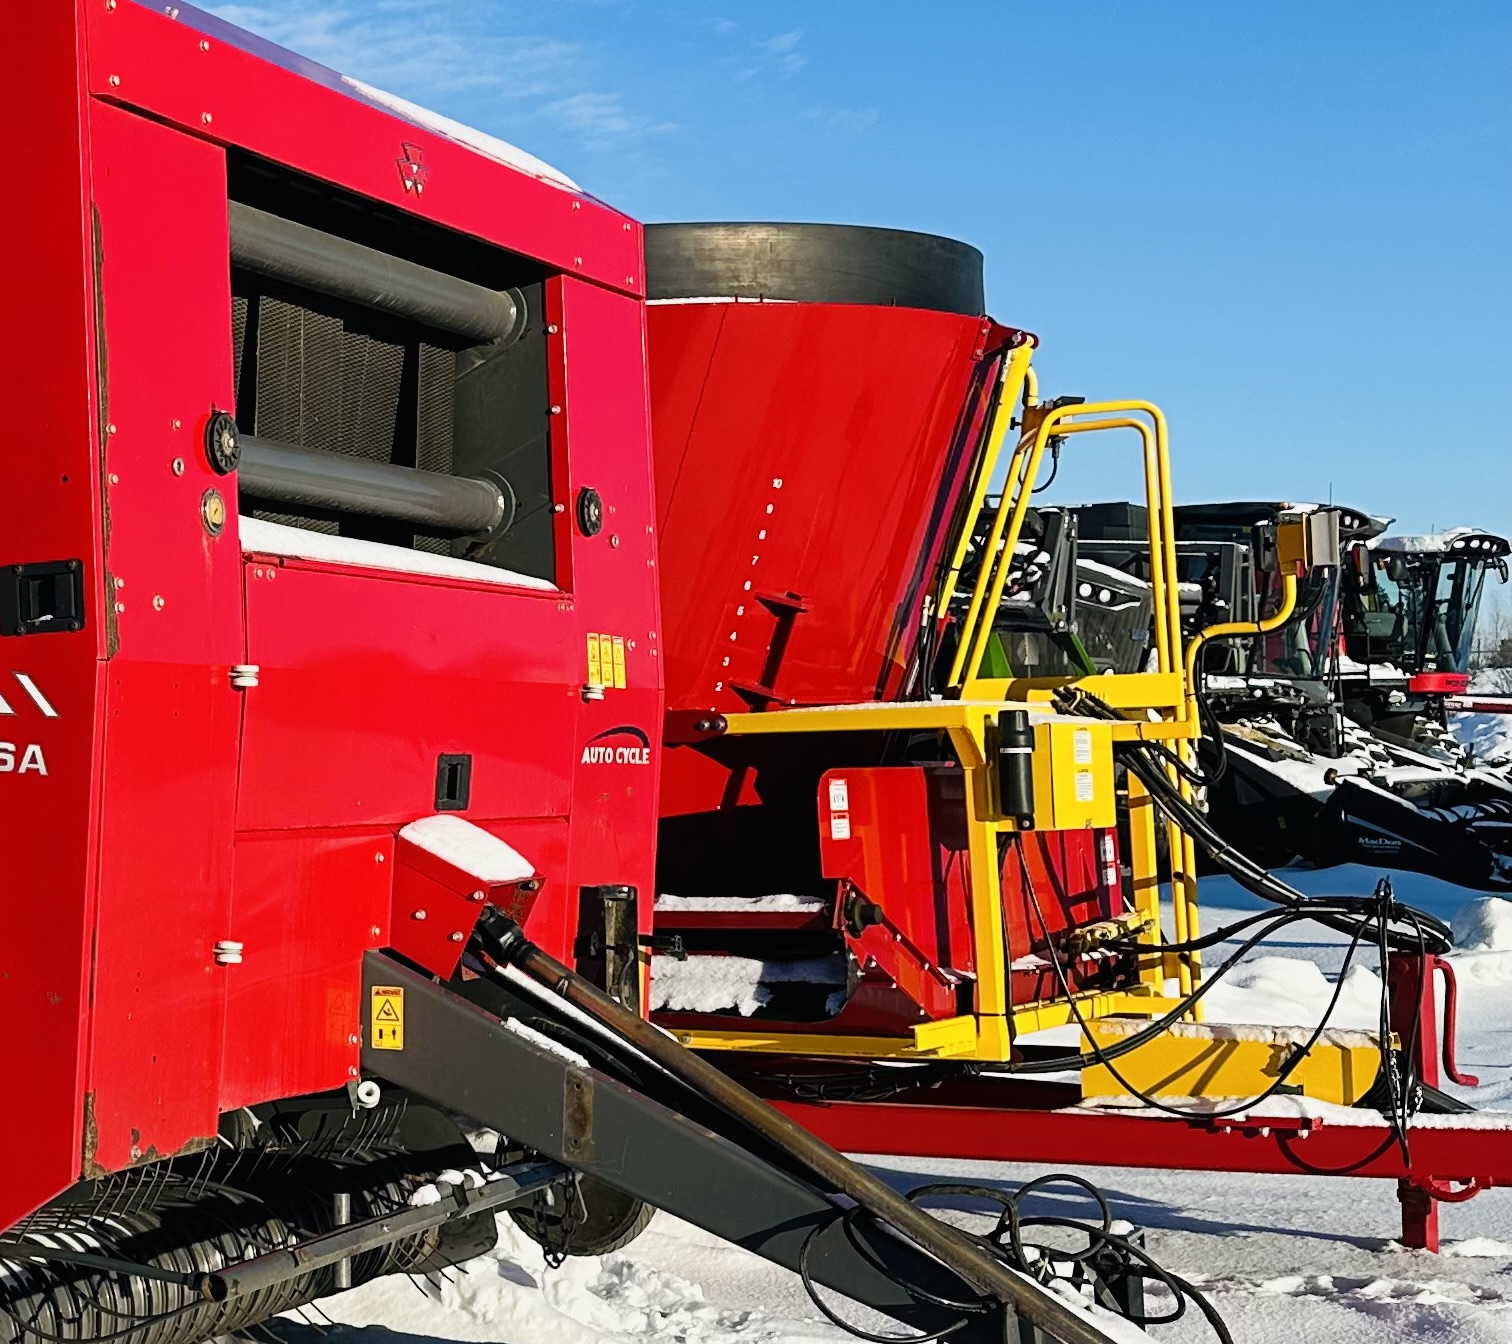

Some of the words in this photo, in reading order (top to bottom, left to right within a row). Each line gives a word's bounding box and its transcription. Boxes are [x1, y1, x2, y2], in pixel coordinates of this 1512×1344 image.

[772, 477, 783, 489] 10
[766, 503, 774, 514] 9
[758, 529, 767, 540] 8
[751, 555, 759, 565] 7
[744, 580, 752, 591] 6
[737, 605, 744, 616] 5
[729, 631, 737, 641] 4
[722, 656, 730, 667] 3
[715, 681, 723, 692] 2
[580, 746, 614, 764] AUTO
[615, 746, 650, 765] CYCLE
